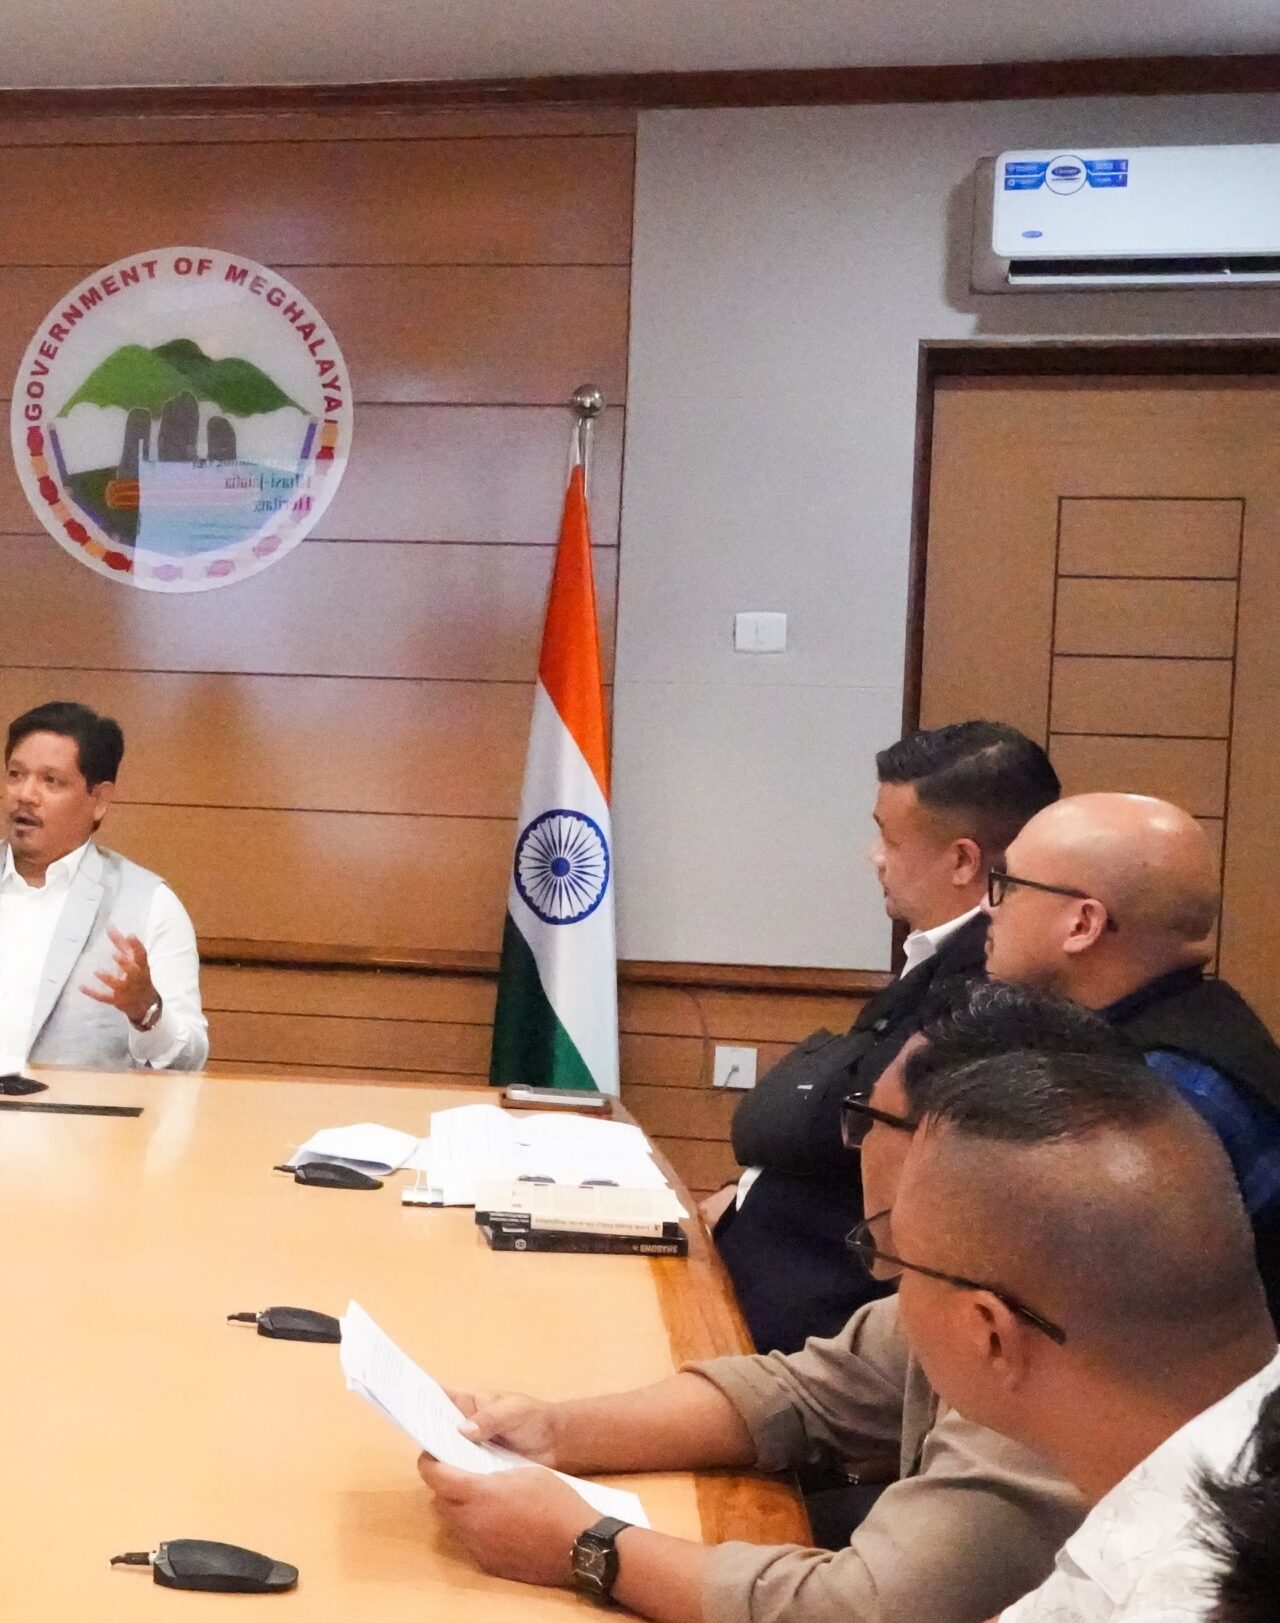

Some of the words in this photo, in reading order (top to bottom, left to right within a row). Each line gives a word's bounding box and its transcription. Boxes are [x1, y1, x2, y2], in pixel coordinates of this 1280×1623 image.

[25, 260, 158, 421] GOVERNMENT
[173, 257, 213, 276] OF
[224, 263, 343, 414] MEGHALAYA
